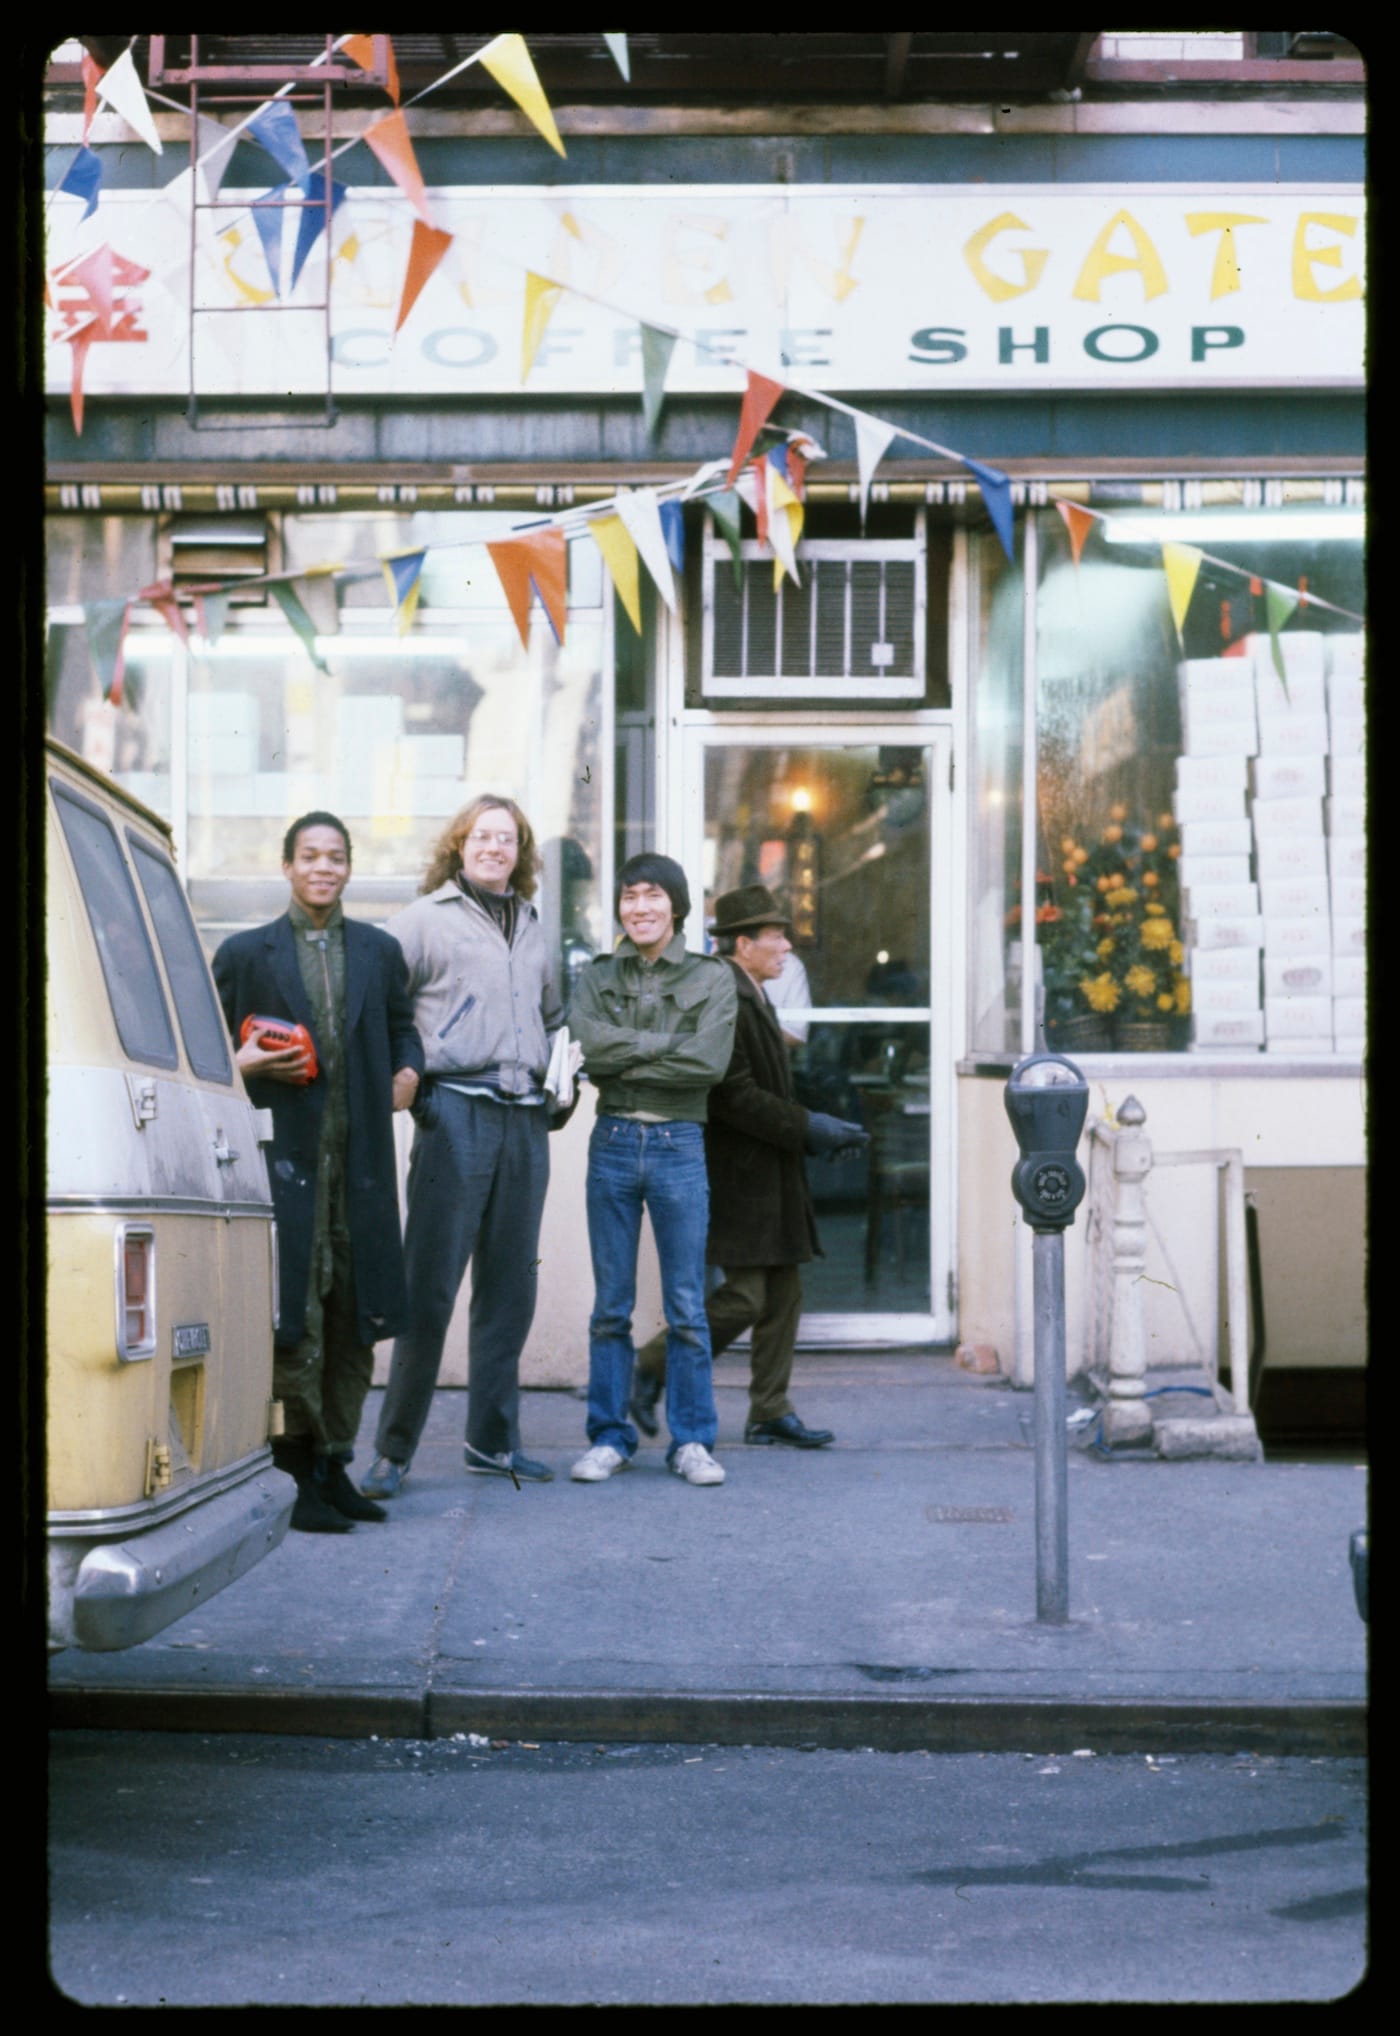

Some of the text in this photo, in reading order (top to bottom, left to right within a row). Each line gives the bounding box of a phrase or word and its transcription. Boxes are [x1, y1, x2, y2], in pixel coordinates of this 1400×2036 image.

[962, 207, 1366, 304] GATE
[330, 322, 1246, 370] COFFEE SHOP
